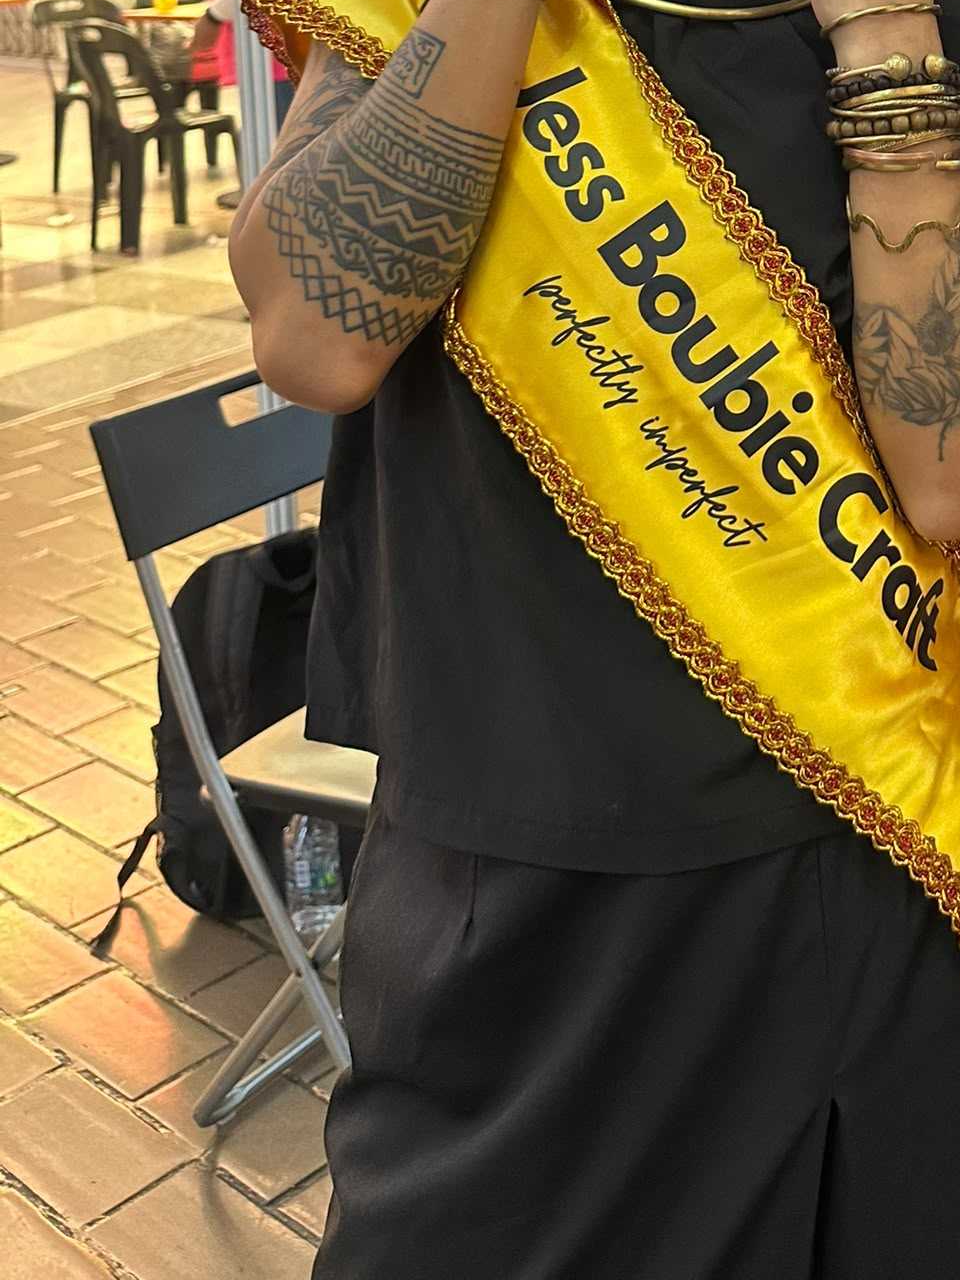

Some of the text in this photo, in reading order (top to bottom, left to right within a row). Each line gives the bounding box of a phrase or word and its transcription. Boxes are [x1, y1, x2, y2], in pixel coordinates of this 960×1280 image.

[523, 274, 769, 548] perfectly imperfect
[596, 199, 819, 496] Boubie
[818, 472, 945, 672] Craft
